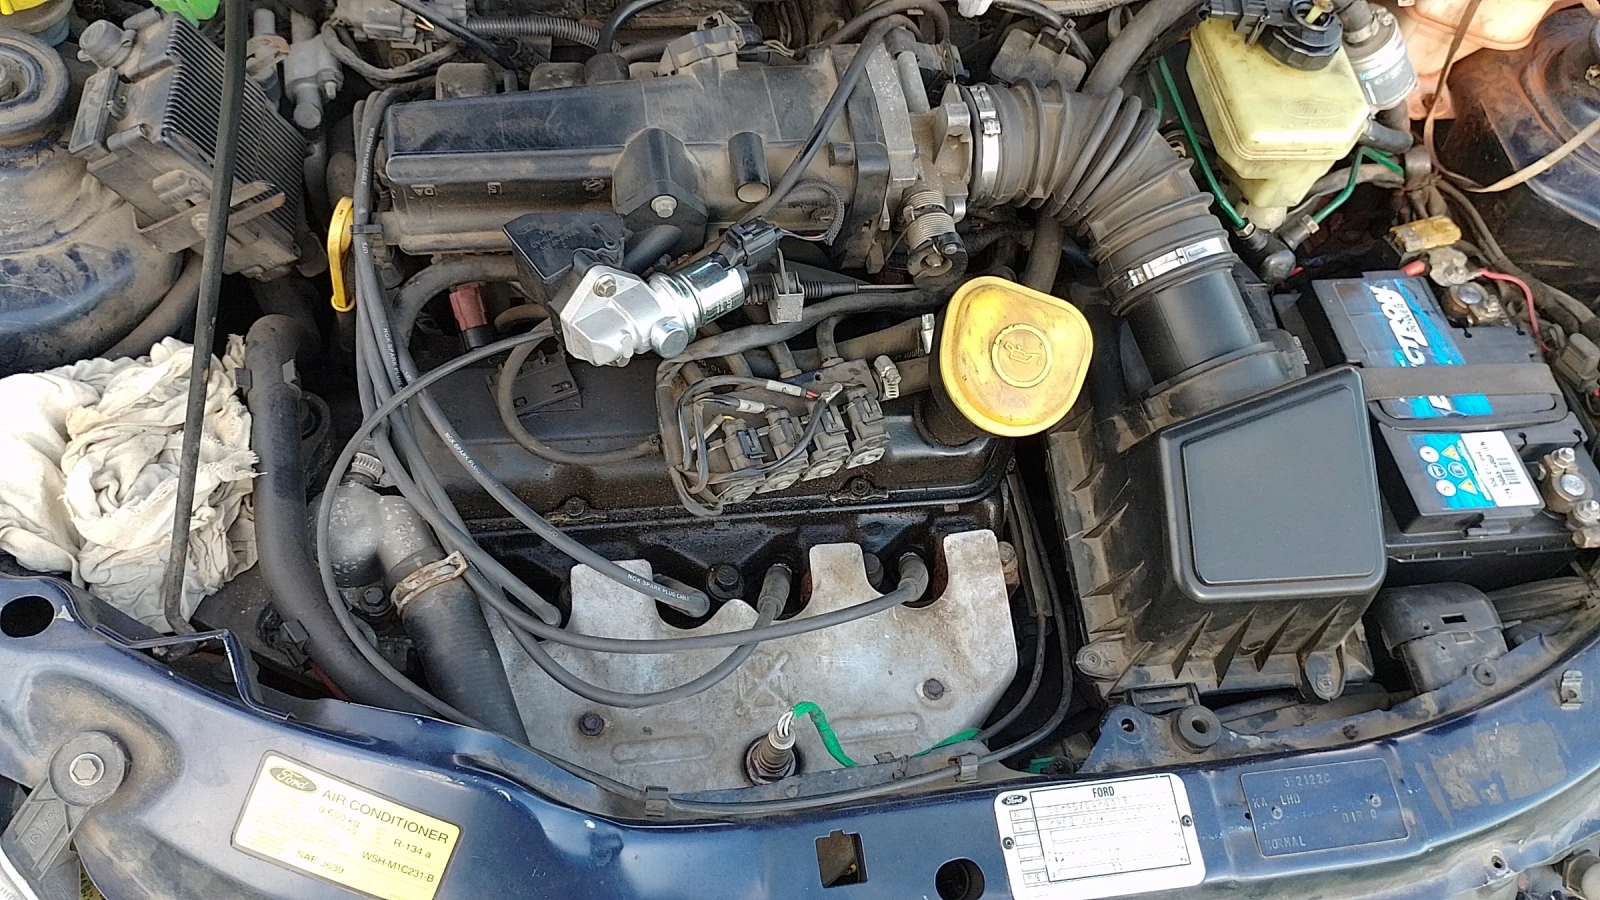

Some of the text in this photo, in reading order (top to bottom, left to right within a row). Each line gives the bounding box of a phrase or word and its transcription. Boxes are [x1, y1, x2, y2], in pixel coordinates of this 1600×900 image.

[387, 343, 398, 366] SPARK
[444, 432, 456, 445] NGK
[453, 443, 470, 461] SPARK
[627, 573, 690, 602] NGK SPARK PLUG CABLE
[273, 767, 314, 792] Ford
[1003, 785, 1115, 806] Ford FORD
[321, 789, 347, 806] AIR
[349, 799, 449, 844] CONDITIONER
[1264, 835, 1307, 851] NORMAL
[296, 849, 345, 875] SAE J639
[362, 851, 435, 883] WSH-M1C231-B
